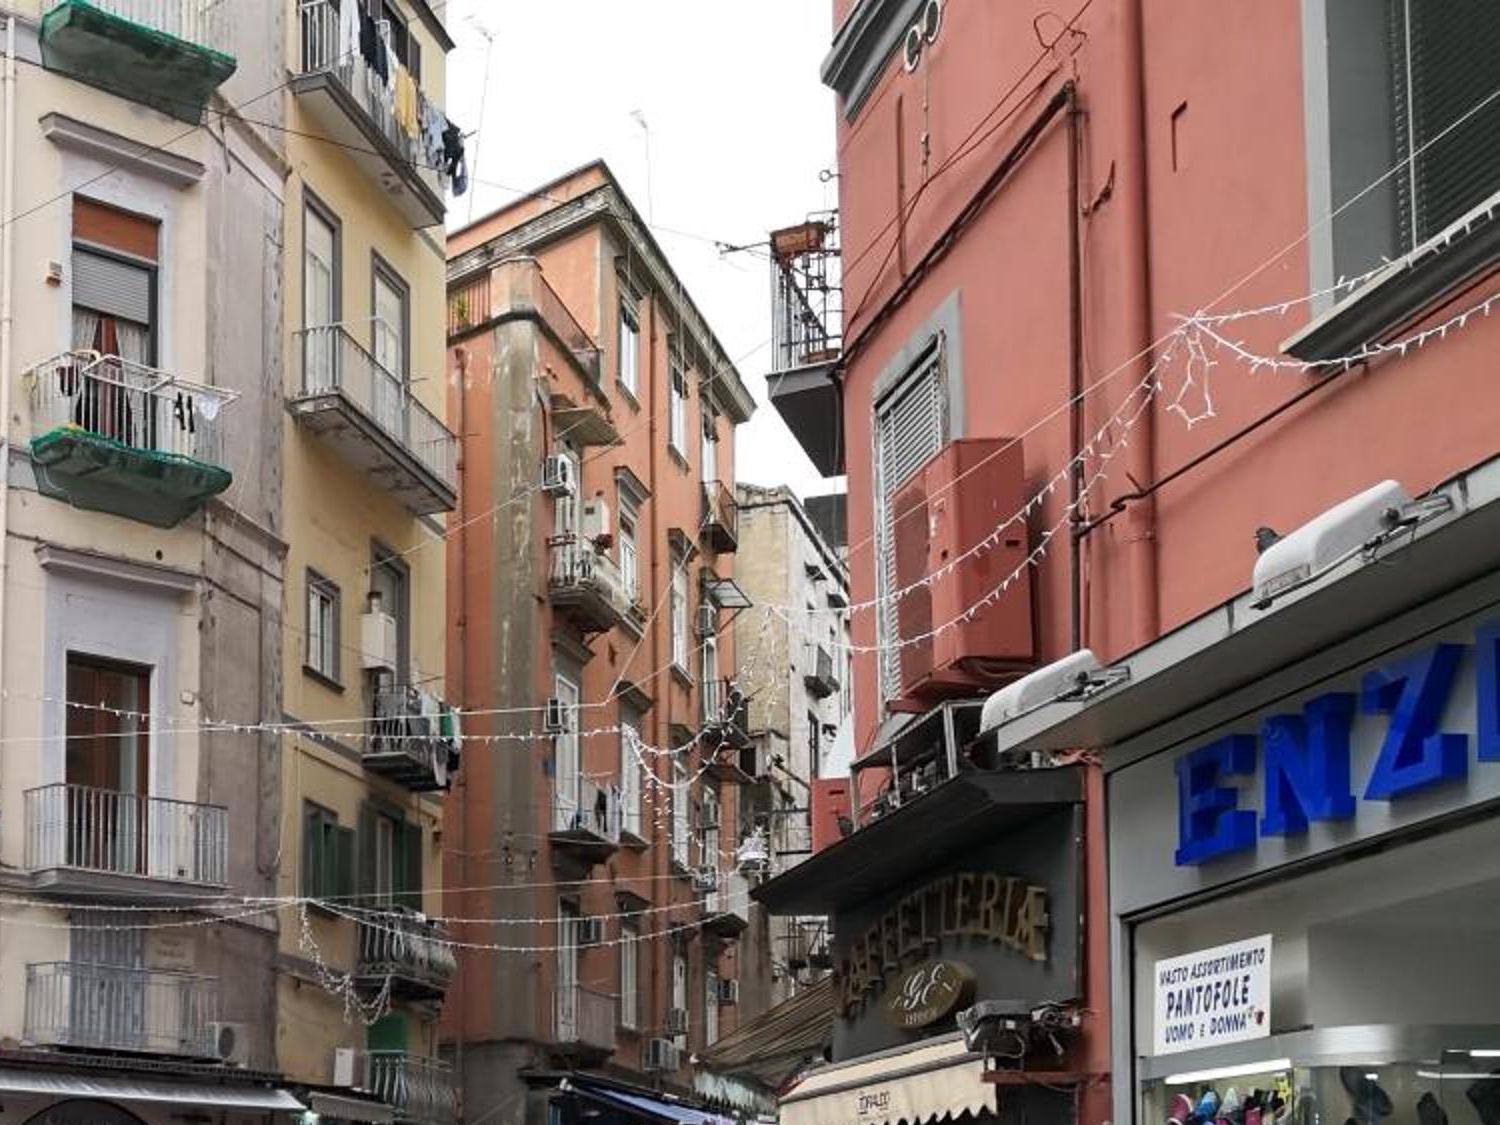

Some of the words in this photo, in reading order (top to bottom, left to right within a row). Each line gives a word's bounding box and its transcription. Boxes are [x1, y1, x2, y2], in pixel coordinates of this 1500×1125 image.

[1160, 967, 1189, 985] VASTO
[1190, 948, 1265, 978] ASSORTIMENTO
[1166, 975, 1250, 1019] PANTOFOLE
[1165, 1023, 1194, 1043] UOMO
[1210, 1012, 1246, 1035] DONNA
